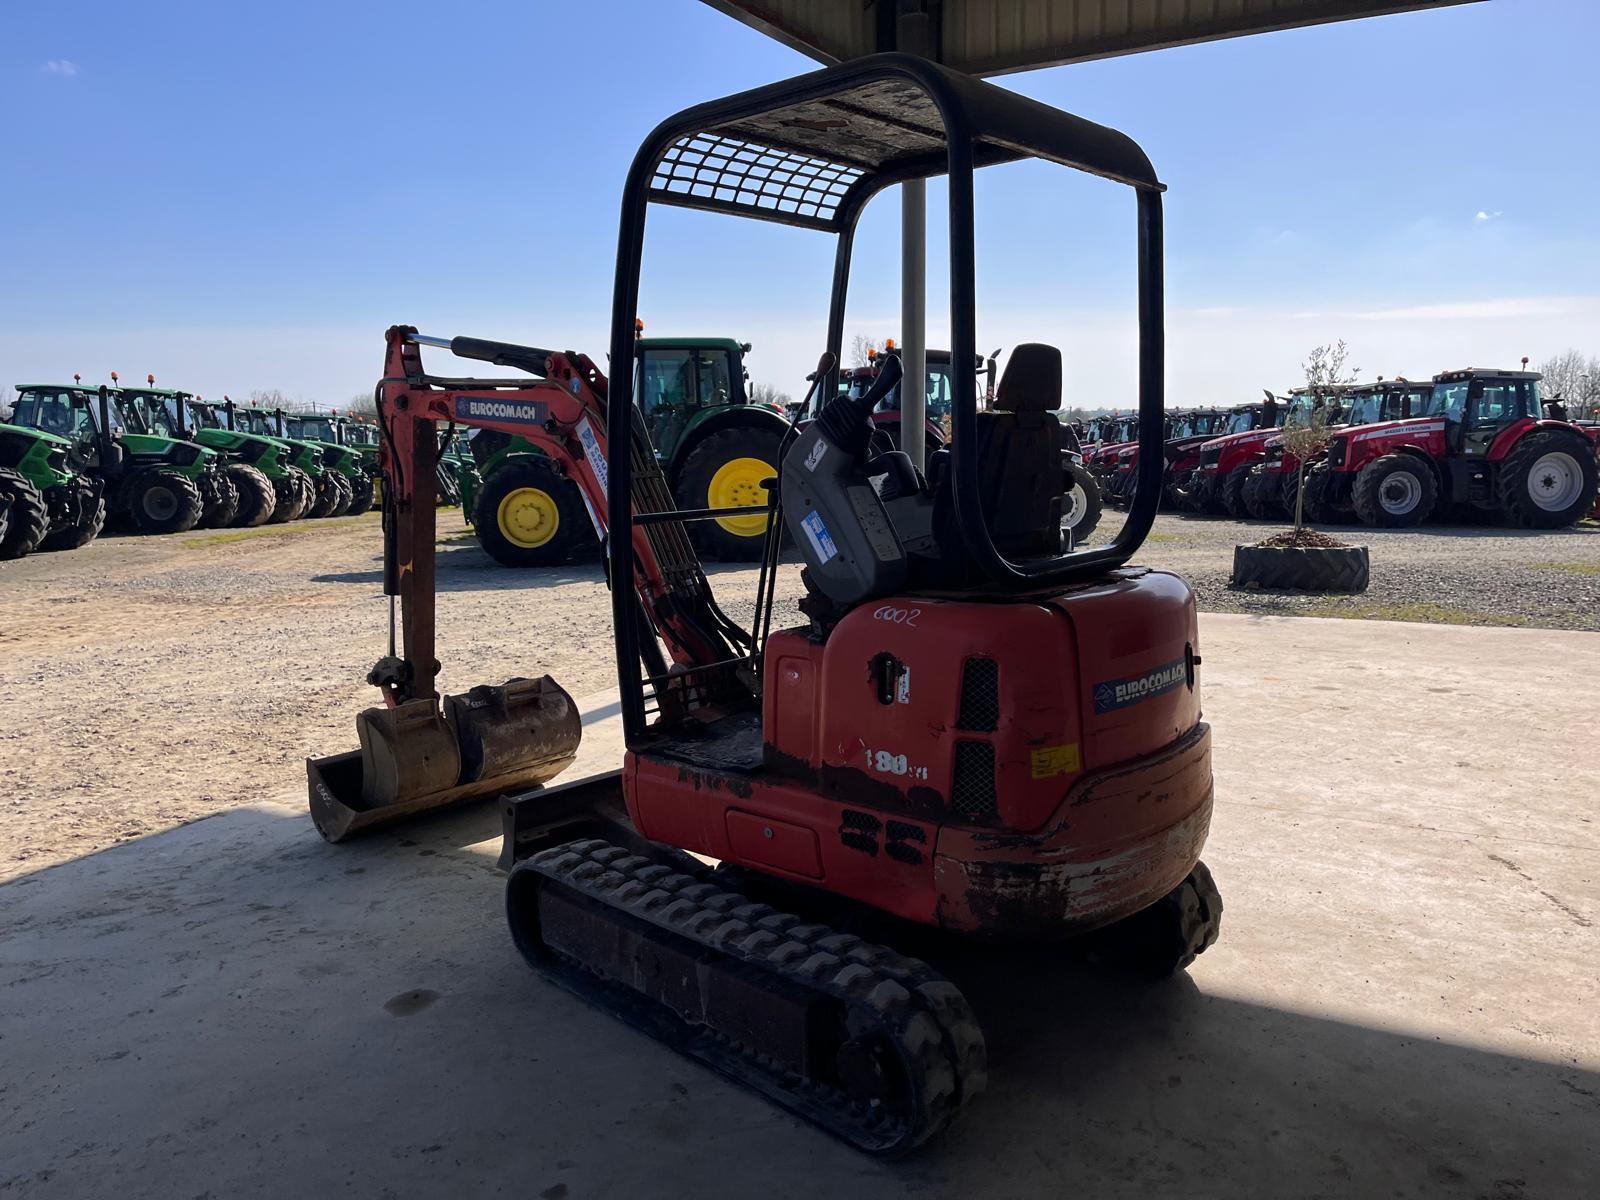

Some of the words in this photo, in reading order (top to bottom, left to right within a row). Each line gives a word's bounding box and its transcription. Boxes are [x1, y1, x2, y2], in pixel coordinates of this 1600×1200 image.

[470, 401, 536, 420] EUROCOMACH
[873, 605, 921, 627] 6002
[1115, 661, 1187, 704] EUROCOMACH
